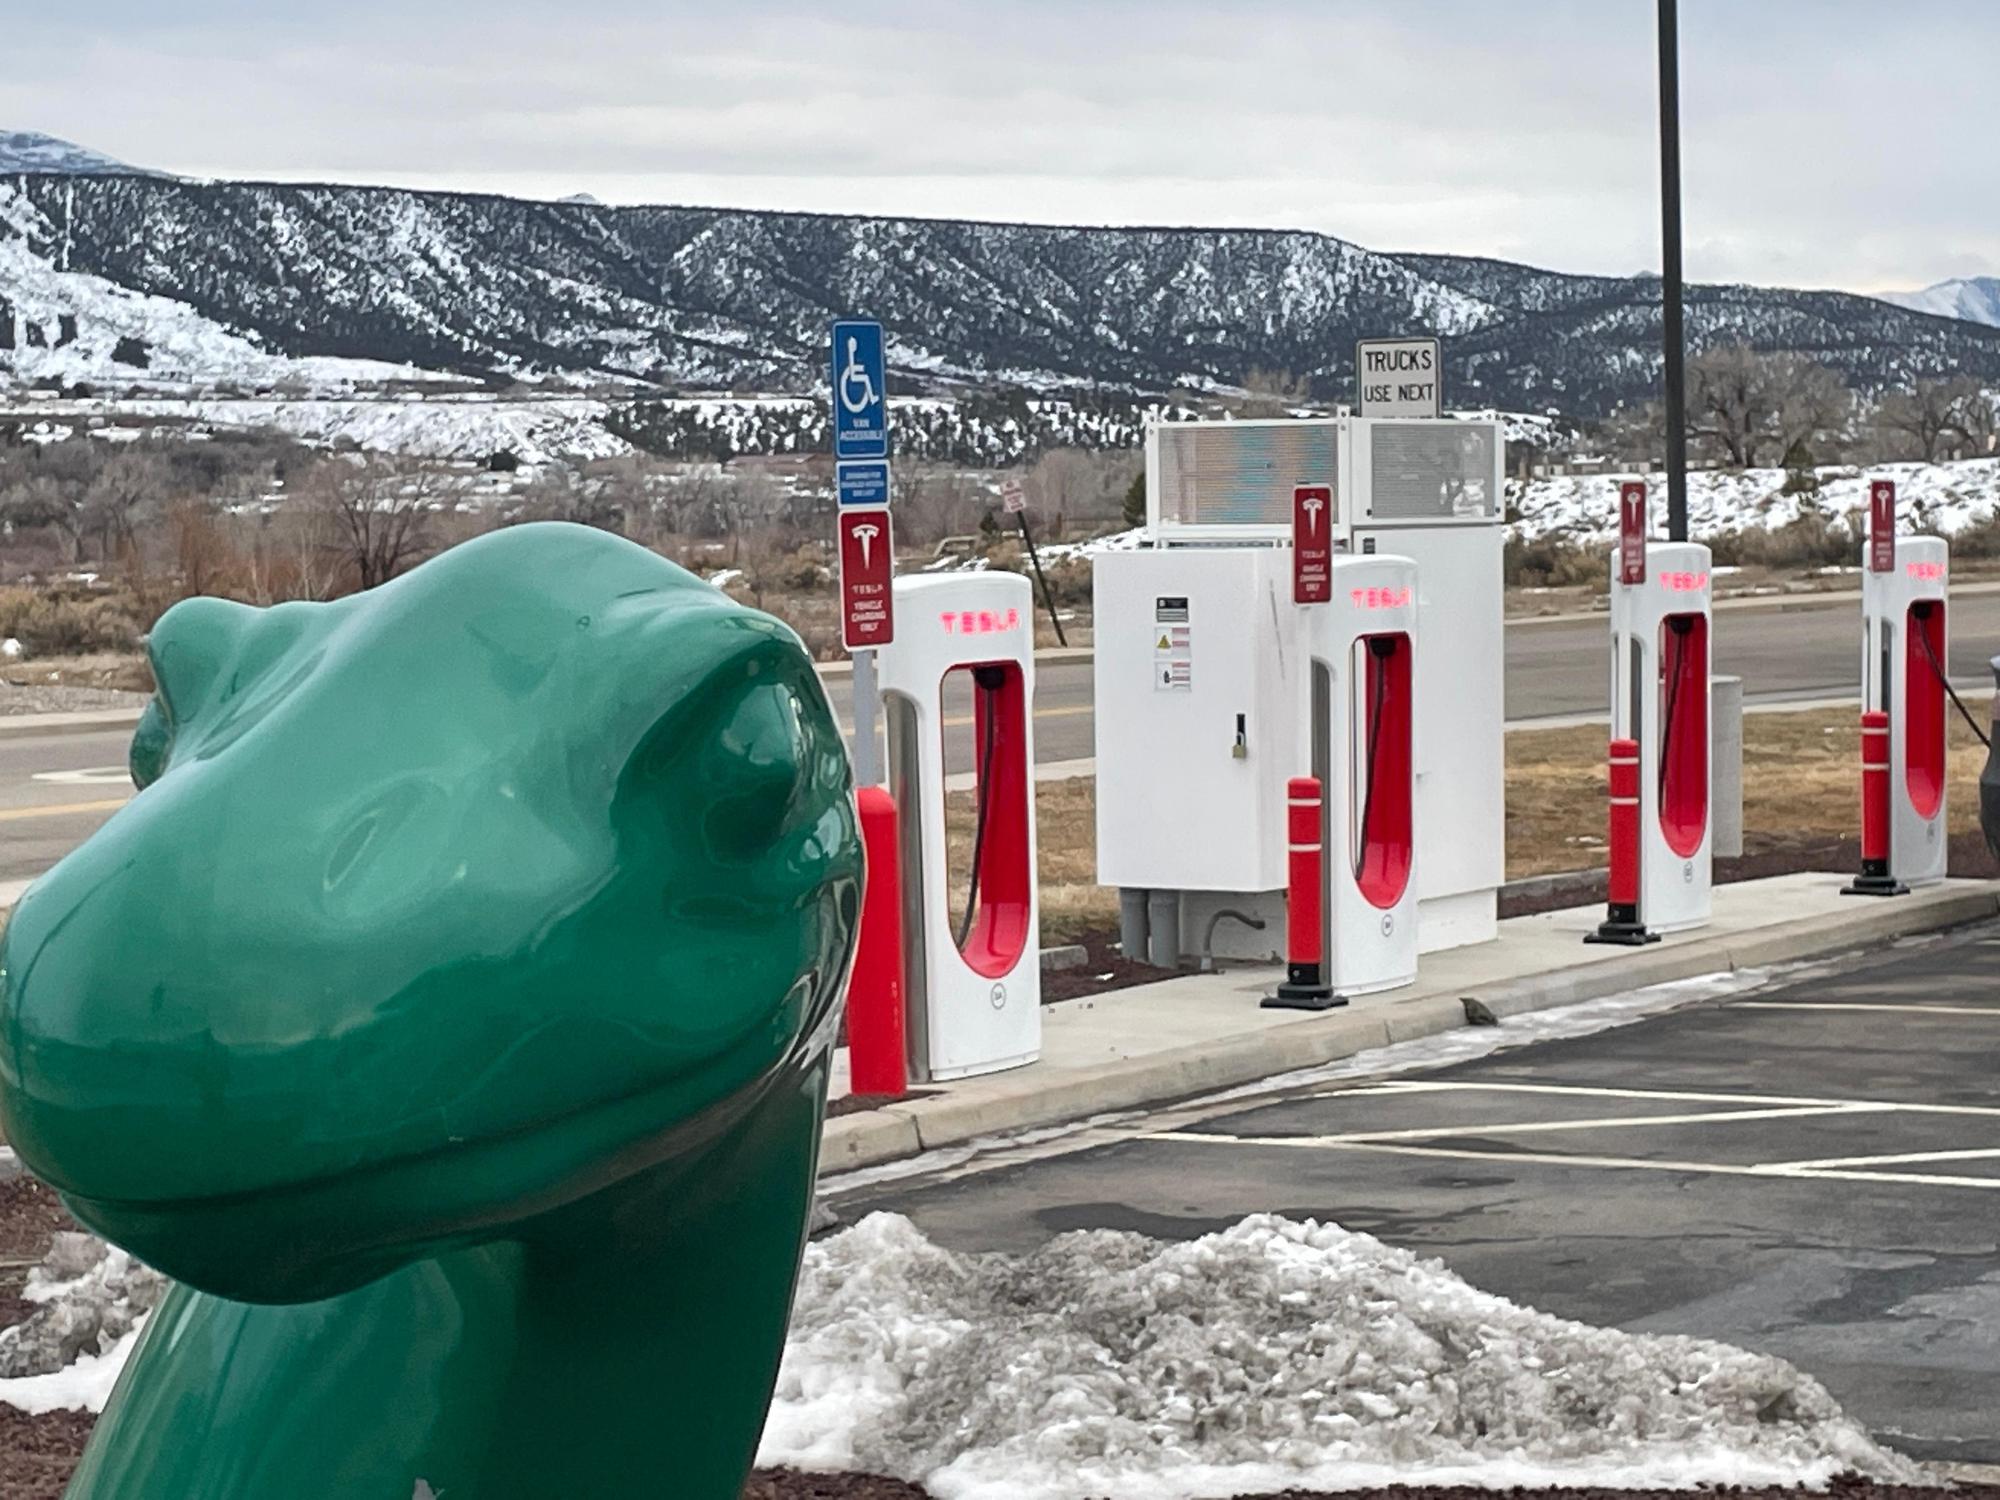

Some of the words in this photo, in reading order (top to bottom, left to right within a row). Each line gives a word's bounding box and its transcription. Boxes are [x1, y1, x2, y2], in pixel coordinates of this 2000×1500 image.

[1365, 350, 1432, 372] TRUCKS
[1364, 385, 1392, 402] USE
[1398, 384, 1434, 402] NEXT
[941, 608, 1019, 635] TESLA
